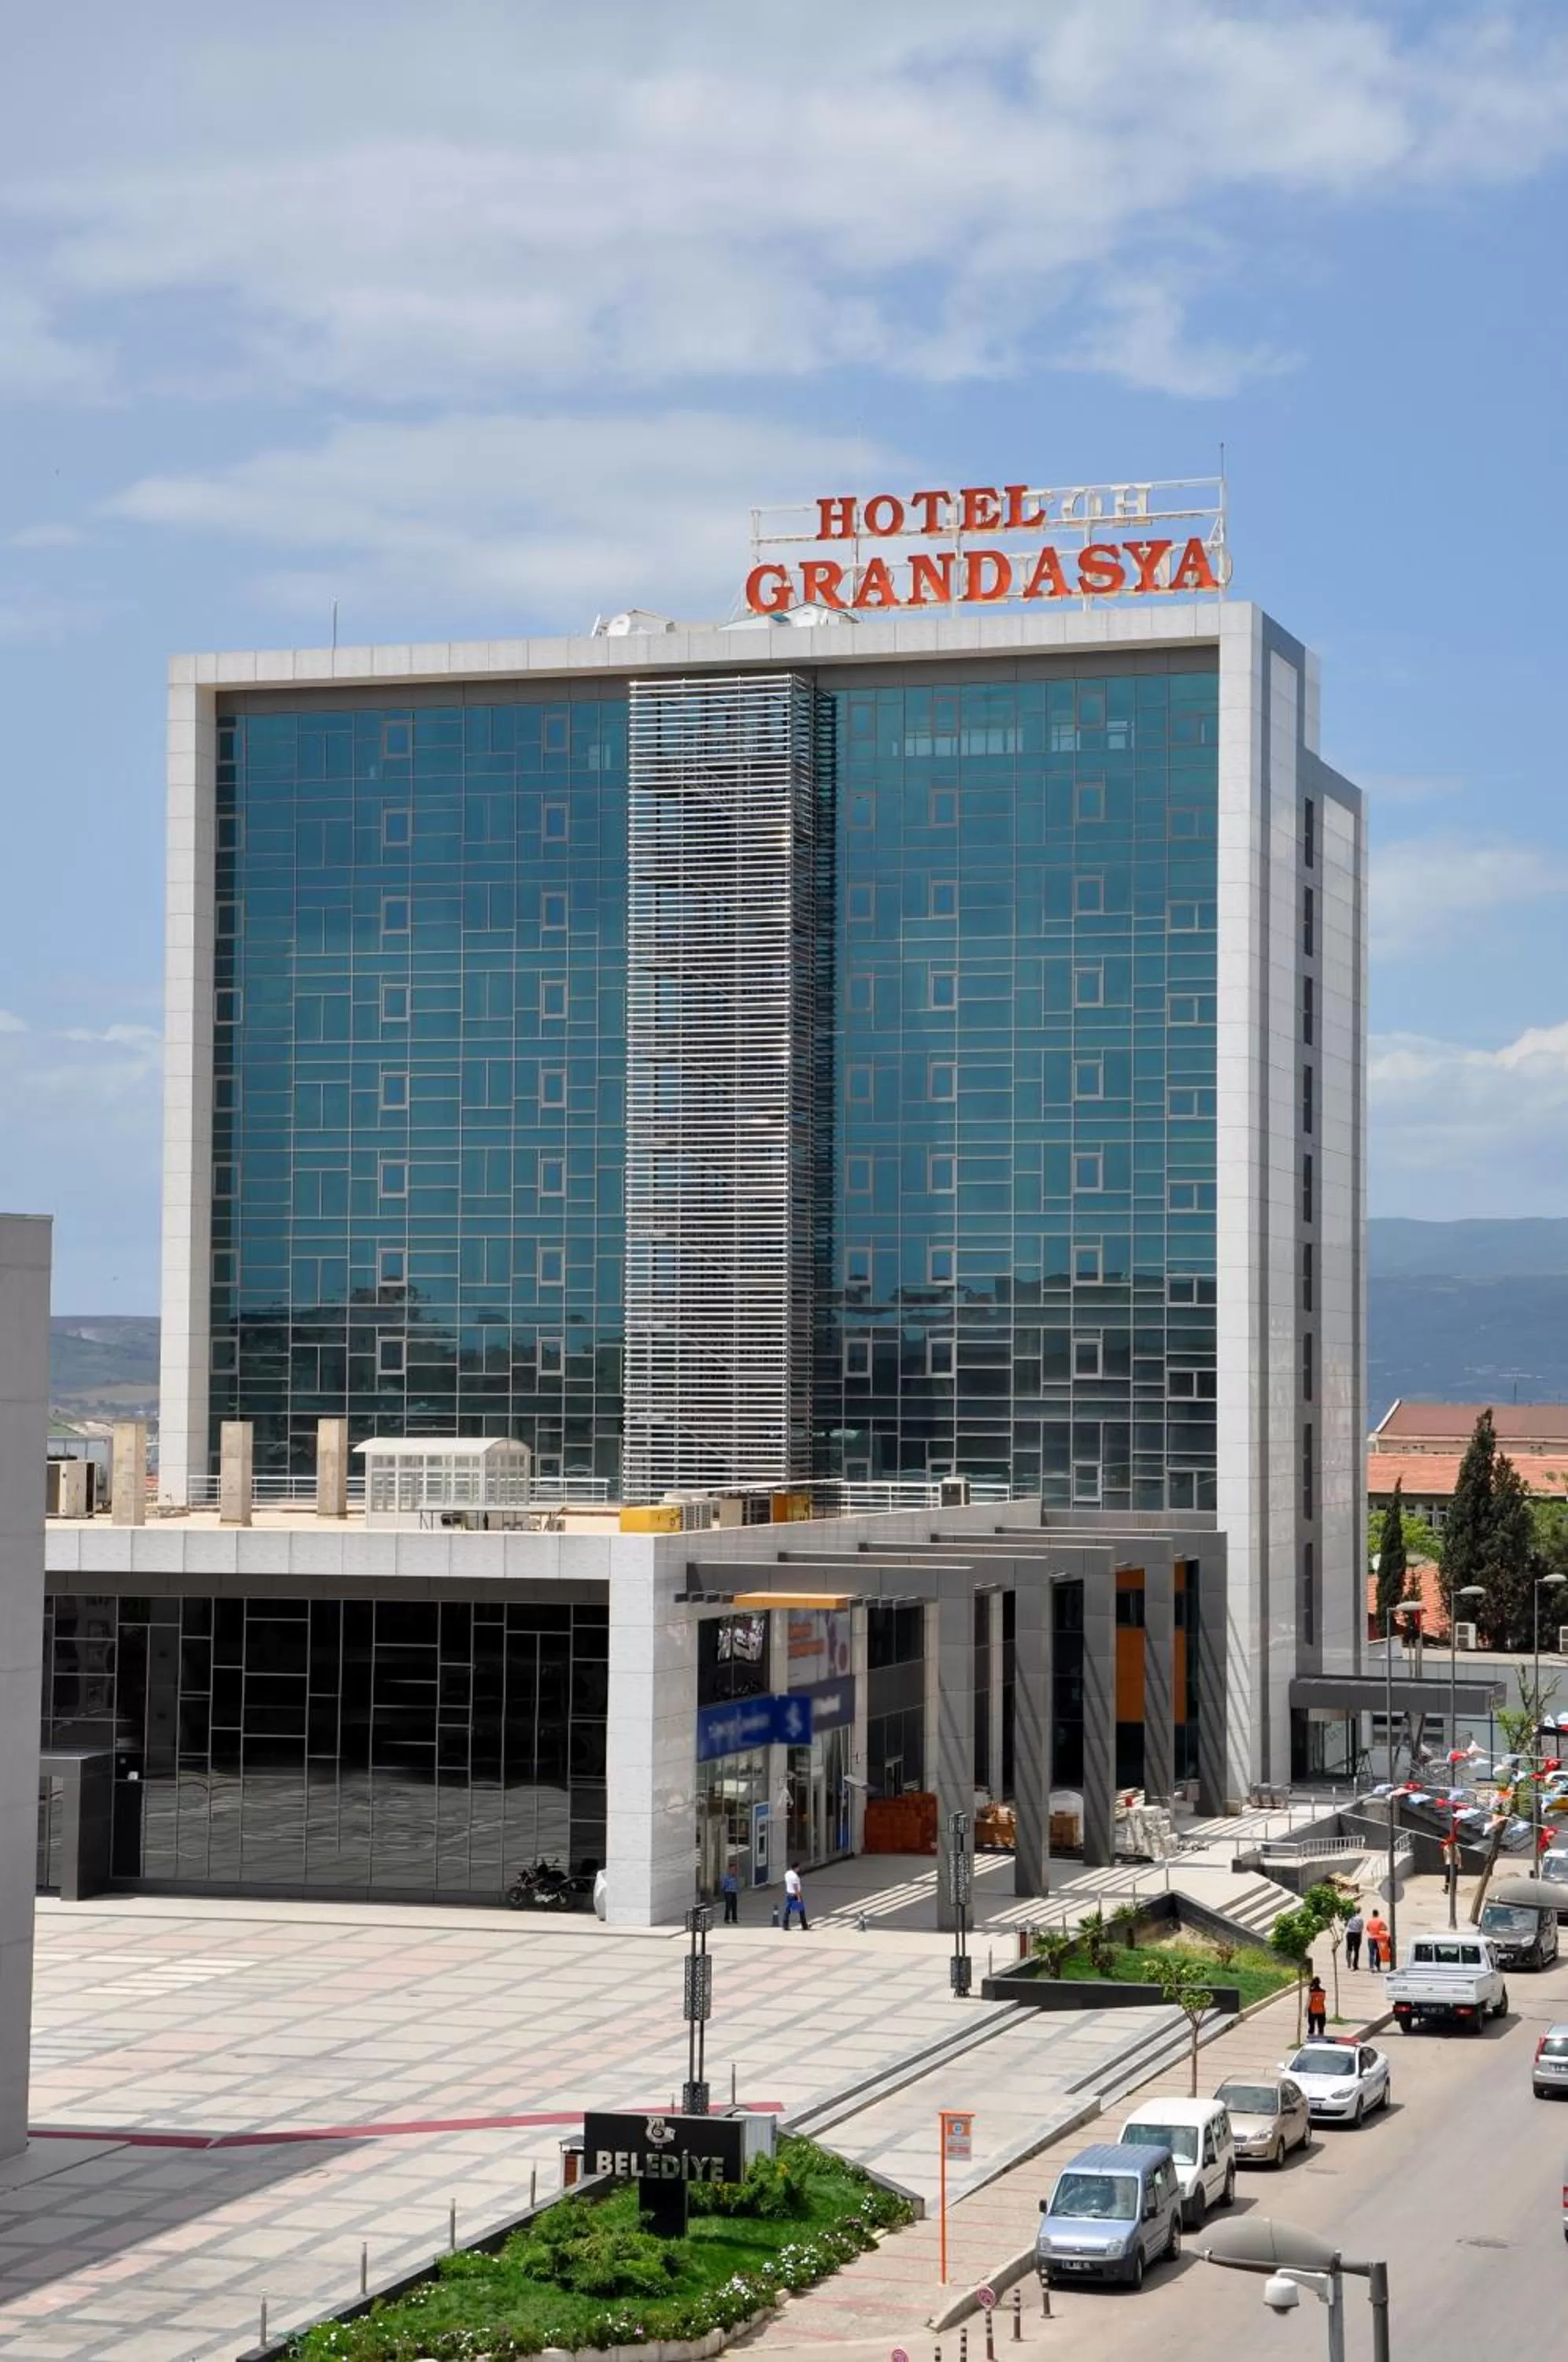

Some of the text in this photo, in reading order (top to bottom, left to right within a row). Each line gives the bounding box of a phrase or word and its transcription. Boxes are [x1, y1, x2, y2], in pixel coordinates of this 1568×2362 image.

[815, 484, 1046, 540] HOTEL
[745, 538, 1219, 614] GRANDASYA
[595, 2149, 725, 2183] BELEDİYE
